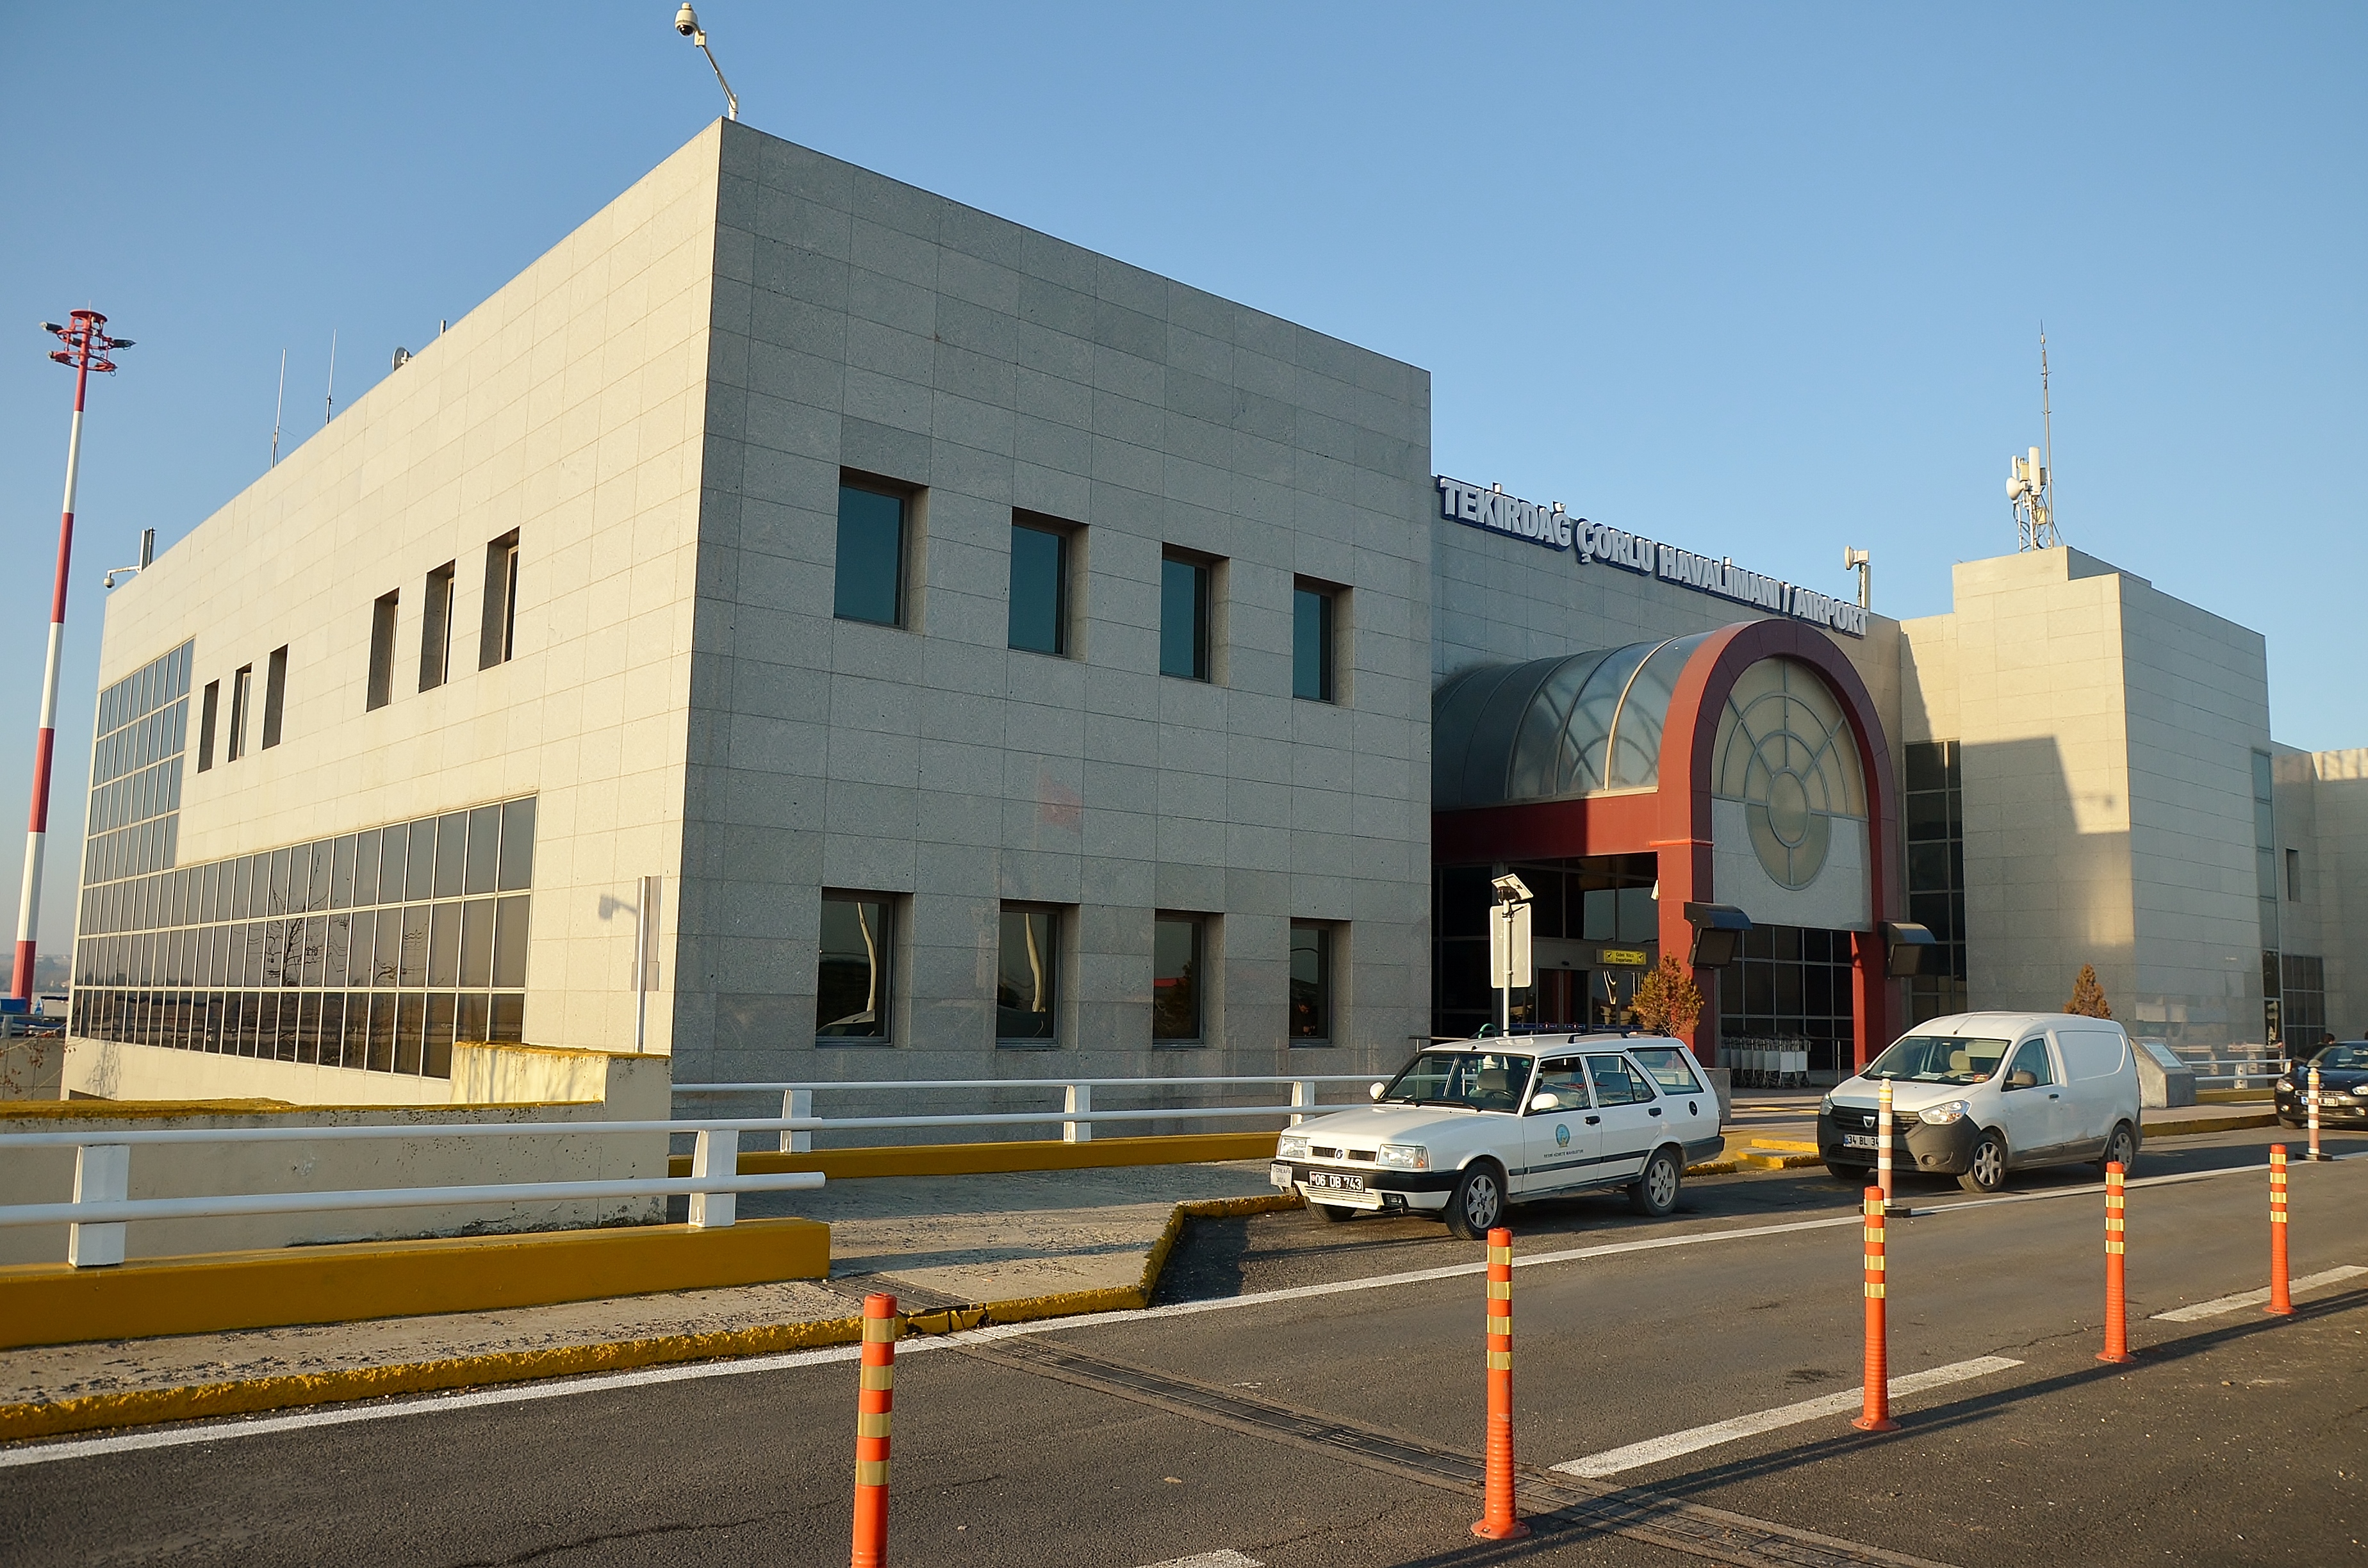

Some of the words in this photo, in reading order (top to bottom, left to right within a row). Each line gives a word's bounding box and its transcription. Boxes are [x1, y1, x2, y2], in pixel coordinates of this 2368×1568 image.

[1440, 478, 1572, 548] TEKİRDAĞ
[1577, 520, 1655, 571] ÇORLU
[1659, 544, 1780, 610] HAVALİMANI
[1793, 587, 1869, 636] AIRPORT
[1848, 1136, 1857, 1145] 34
[1859, 1137, 1868, 1145] BL
[1315, 1173, 1326, 1186] 06
[1329, 1175, 1342, 1188] DB
[1343, 1177, 1362, 1190] 743
